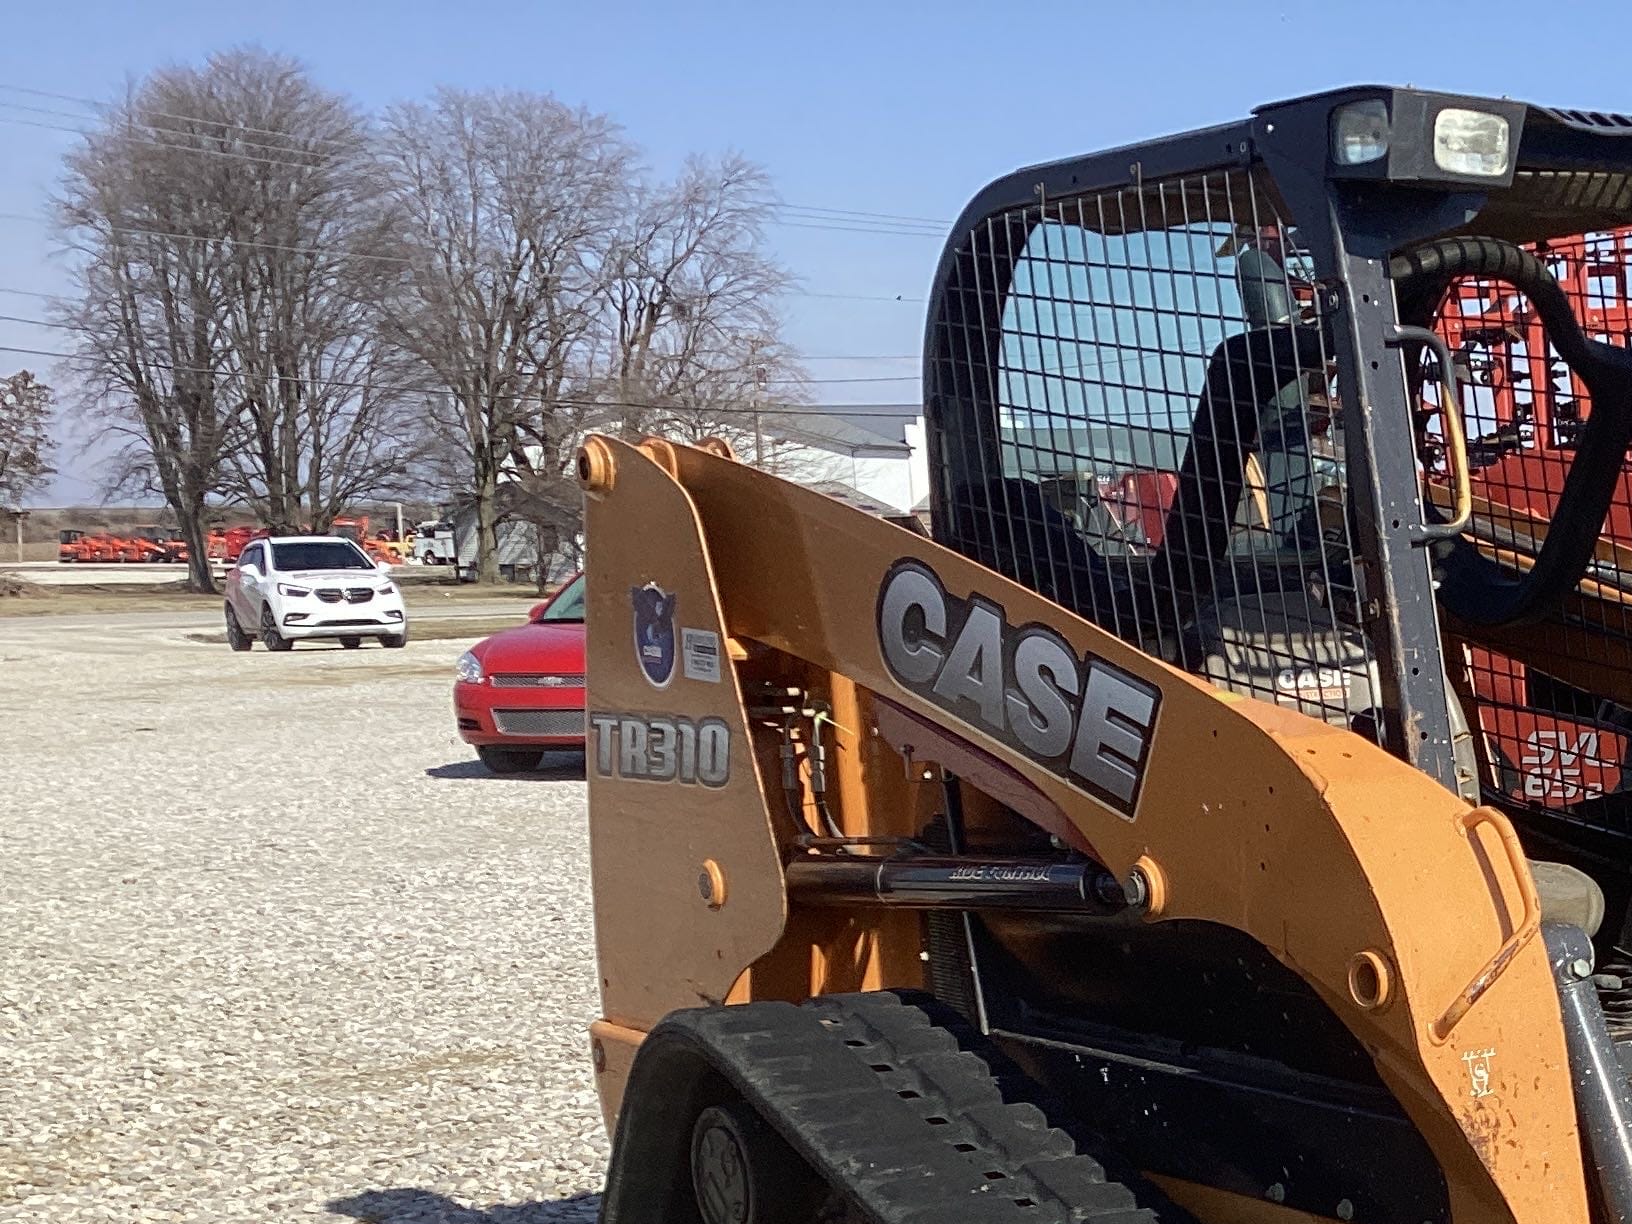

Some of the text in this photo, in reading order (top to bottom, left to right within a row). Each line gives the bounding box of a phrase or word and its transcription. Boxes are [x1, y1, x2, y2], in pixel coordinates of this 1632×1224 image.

[879, 562, 1160, 806] CASE
[1279, 667, 1350, 689] CASE
[590, 712, 731, 788] TR310
[1521, 731, 1616, 768] SVL
[1525, 767, 1604, 800] 65-2
